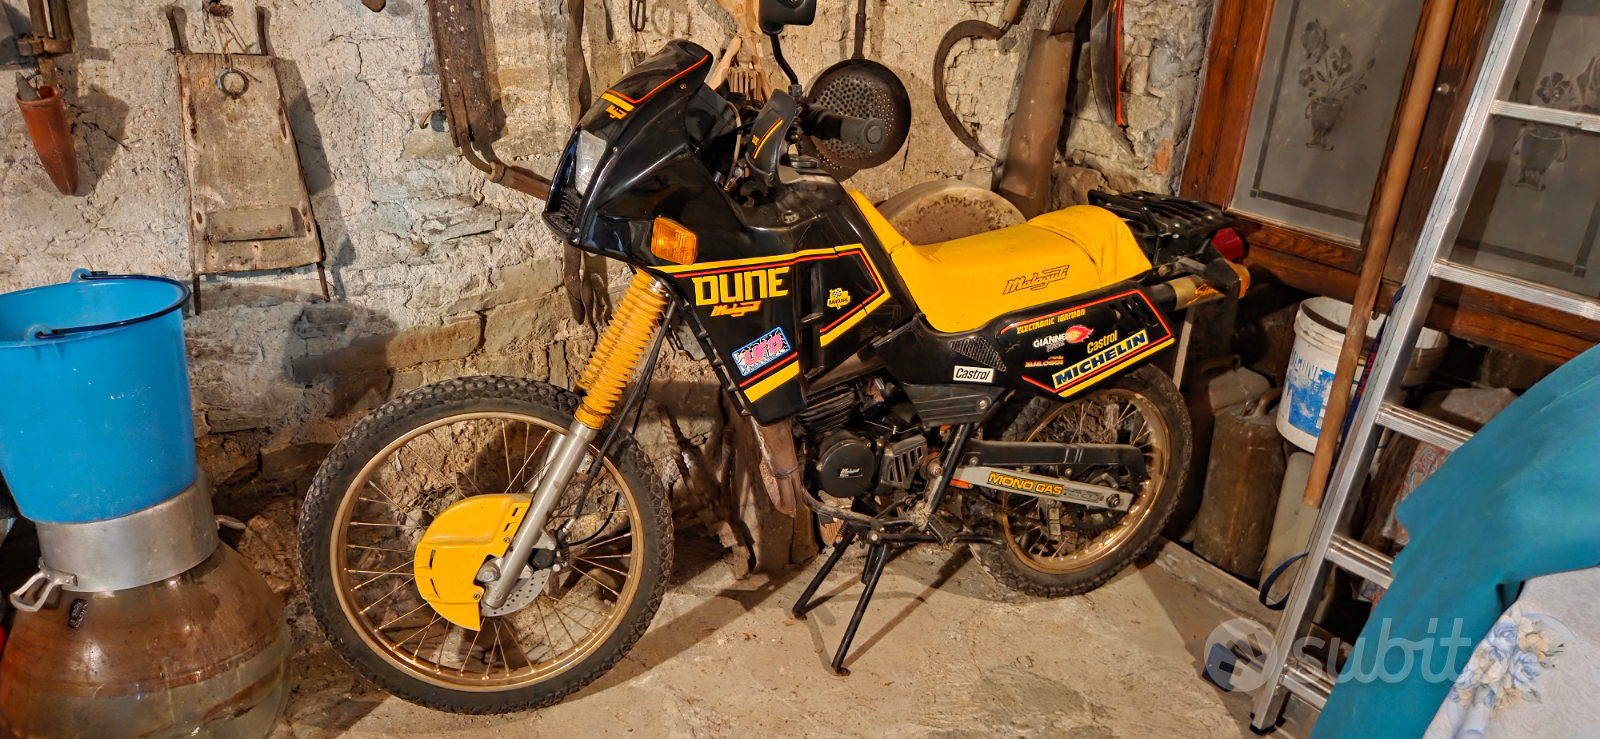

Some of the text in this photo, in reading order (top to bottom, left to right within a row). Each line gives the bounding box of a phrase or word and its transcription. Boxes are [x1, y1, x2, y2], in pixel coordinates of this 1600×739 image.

[692, 266, 790, 306] DUNE
[1002, 264, 1070, 295] Malaguti
[709, 300, 762, 317] Malaguti
[1016, 308, 1085, 334] ELECTRONIC IGNITION
[744, 334, 782, 365] UFO
[1087, 329, 1118, 354] Castrol
[1055, 332, 1146, 386] MICHELIN
[955, 367, 991, 380] Castrol
[988, 471, 1033, 490] MONO
[1035, 482, 1063, 496] GAS
